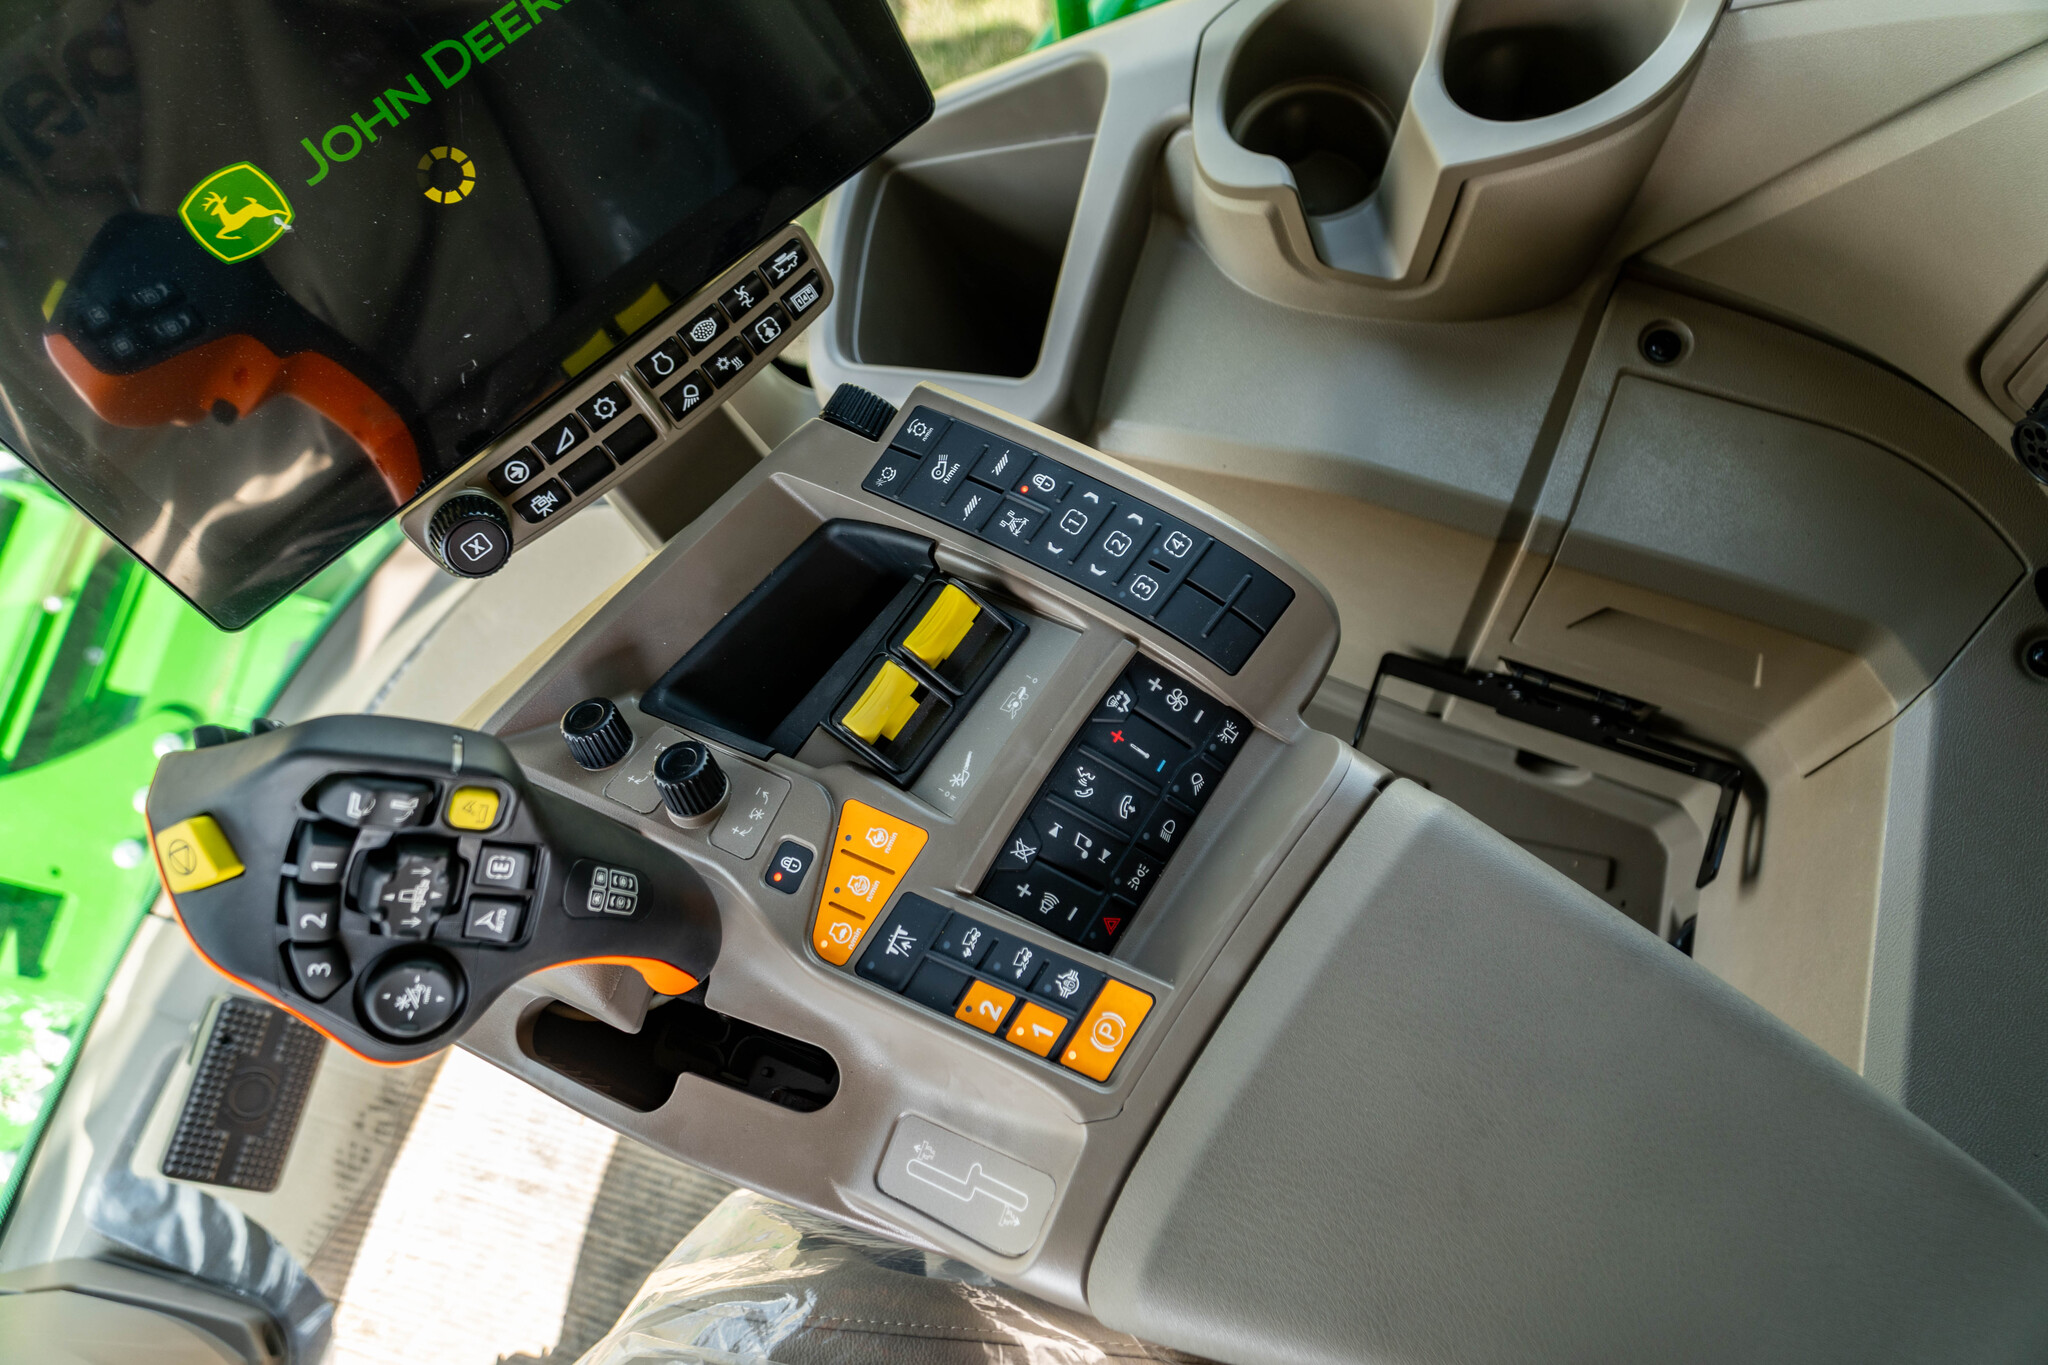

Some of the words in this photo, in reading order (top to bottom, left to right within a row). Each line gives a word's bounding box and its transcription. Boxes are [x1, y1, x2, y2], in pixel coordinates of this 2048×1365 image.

[301, 73, 432, 187] JOHN
[421, 0, 574, 90] DEER
[922, 427, 934, 442] n/min
[942, 463, 961, 484] n/min
[467, 538, 486, 555] X
[1111, 539, 1126, 551] 2
[1172, 538, 1185, 550] 4
[1137, 582, 1152, 595] 3
[884, 832, 898, 854] n/min
[311, 861, 338, 872] 1
[491, 861, 510, 873] E
[866, 880, 880, 903] n/min
[300, 912, 328, 929] 2
[494, 908, 508, 934] AUTO
[848, 927, 862, 950] n/min
[307, 962, 332, 978] 3
[979, 1000, 1003, 1022] 2
[1032, 1023, 1054, 1037] 1
[1098, 1022, 1115, 1041] P
